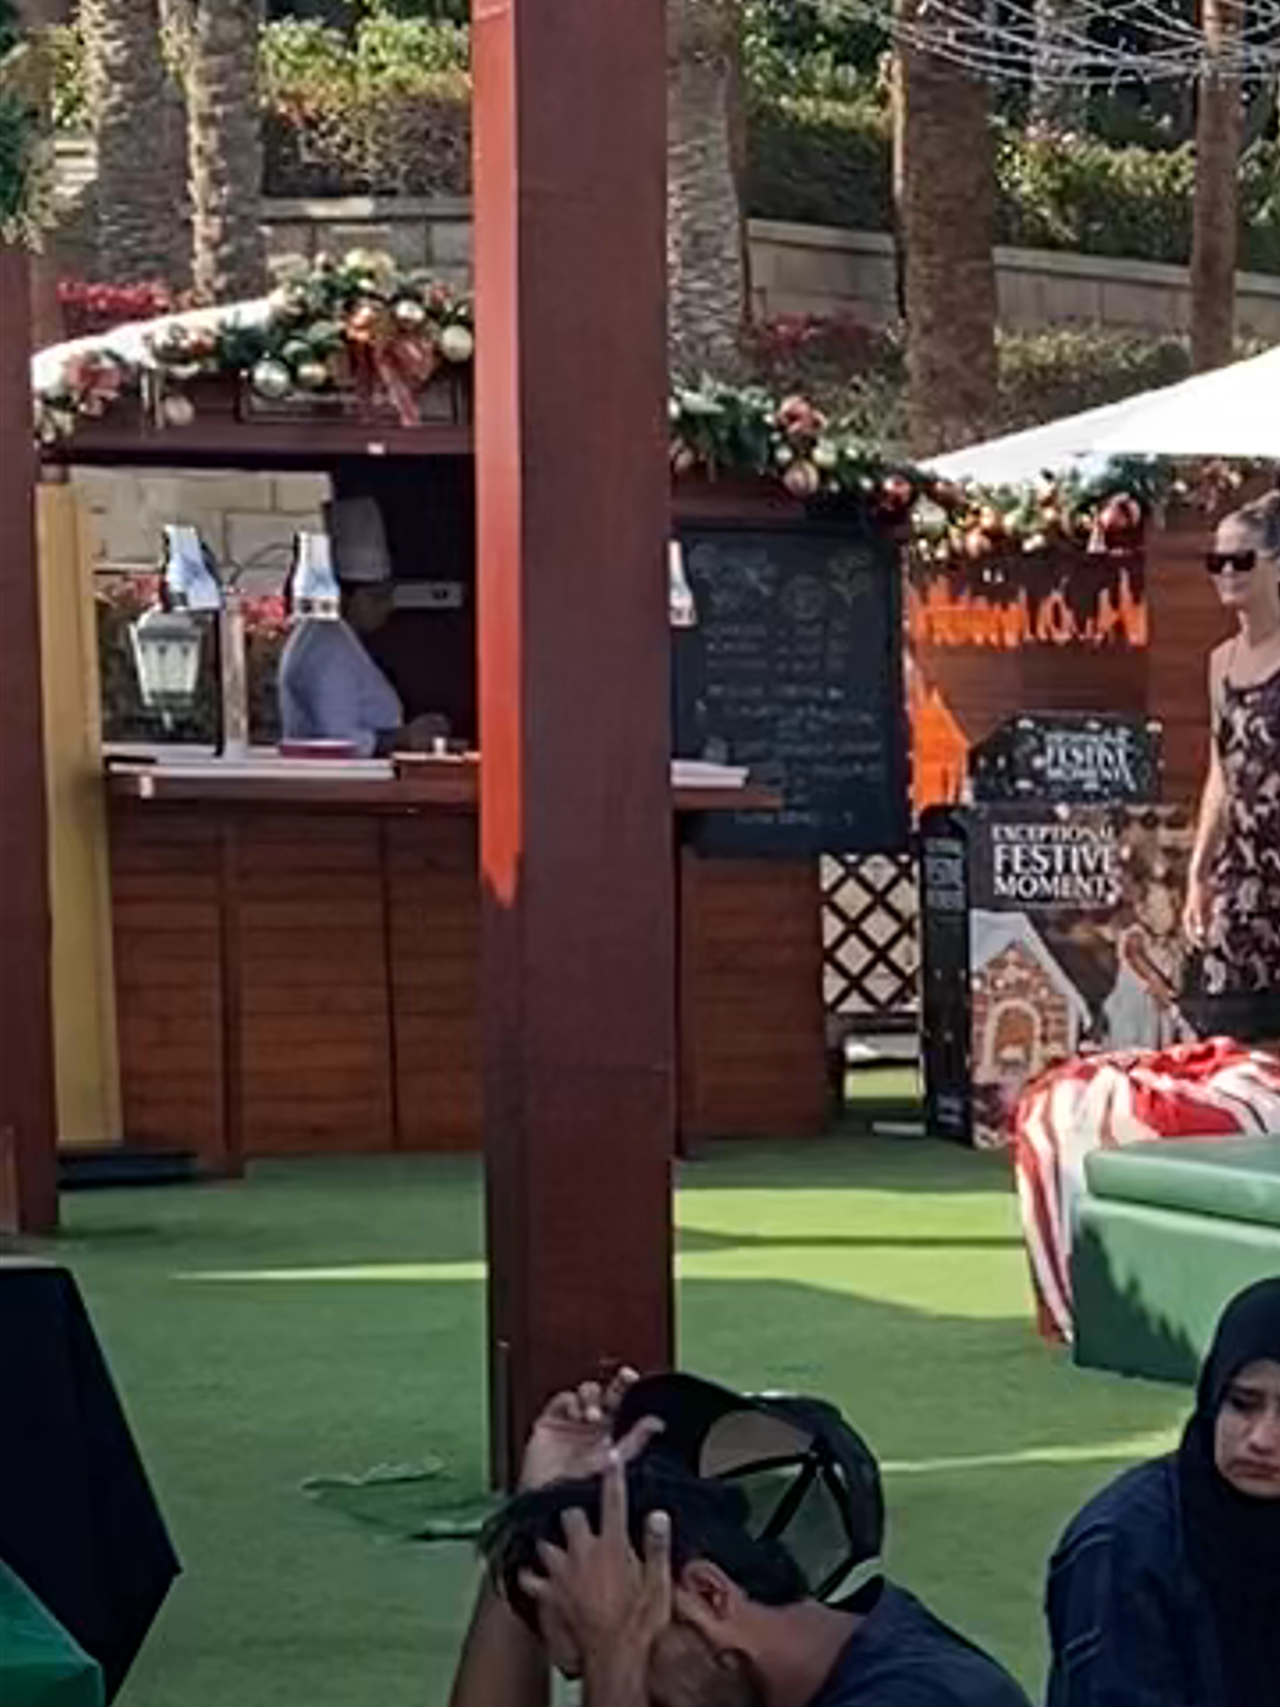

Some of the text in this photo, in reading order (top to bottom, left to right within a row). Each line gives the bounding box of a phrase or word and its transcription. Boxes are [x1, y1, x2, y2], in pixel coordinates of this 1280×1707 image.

[993, 824, 1114, 843] EXCEPTIONAL
[994, 844, 1118, 874] FESTIVE
[994, 875, 1123, 898] MOMENTS
